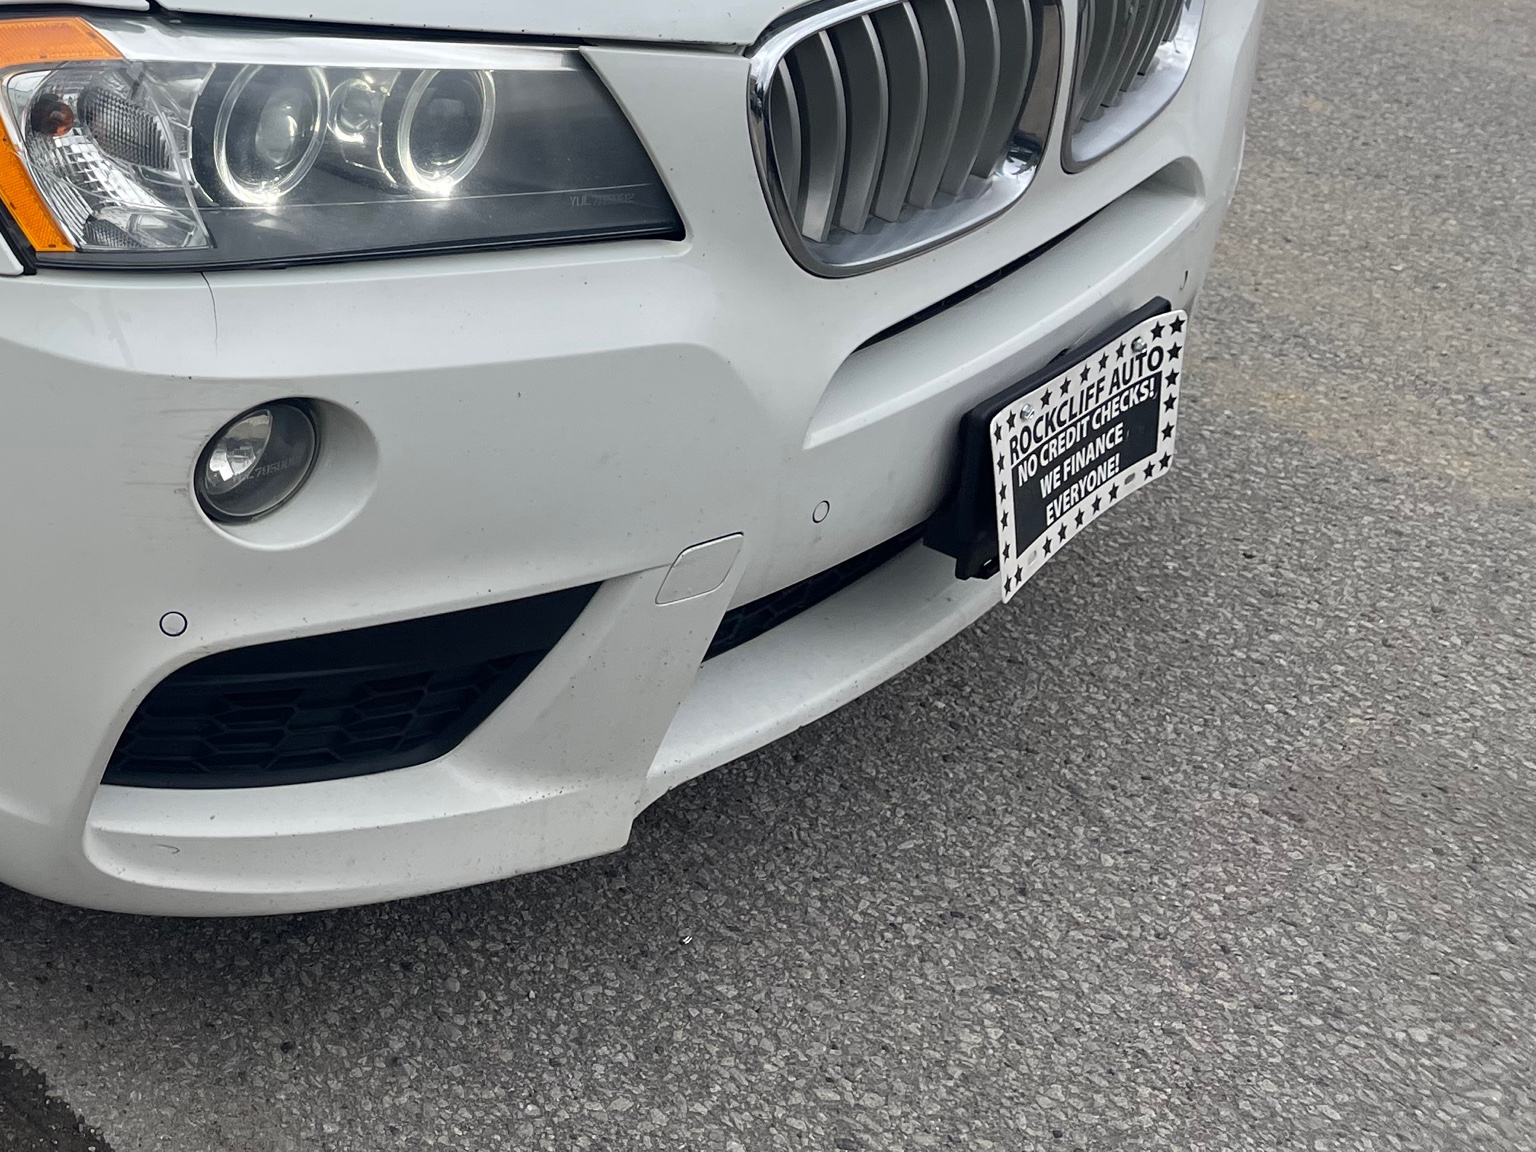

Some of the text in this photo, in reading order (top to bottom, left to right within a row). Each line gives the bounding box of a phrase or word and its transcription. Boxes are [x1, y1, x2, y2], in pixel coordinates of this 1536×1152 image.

[1010, 346, 1164, 465] ROCKCLIFF AUTO
[1017, 378, 1156, 487] NO CREDIT CHECKS!
[1039, 423, 1124, 499] WE FINANCE
[1045, 453, 1121, 527] EVERYONE!
